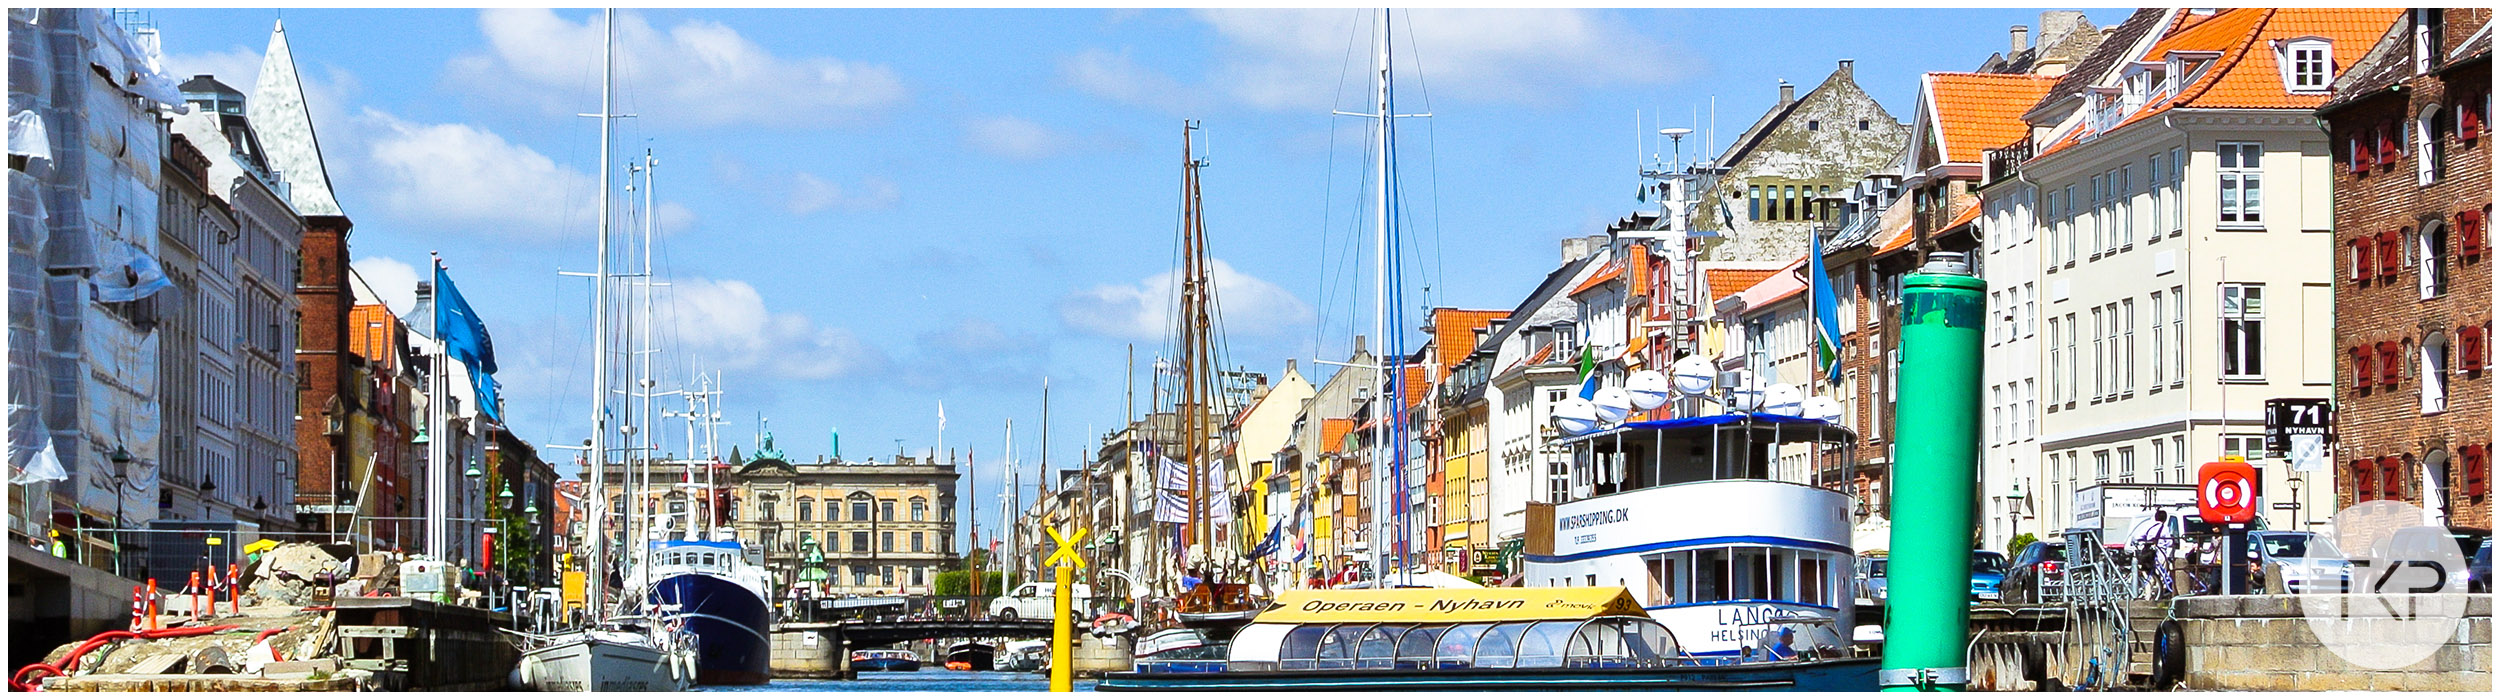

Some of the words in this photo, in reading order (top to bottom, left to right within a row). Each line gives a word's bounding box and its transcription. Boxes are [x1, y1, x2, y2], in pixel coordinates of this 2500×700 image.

[2266, 406, 2276, 425] 71
[2290, 405, 2319, 425] 71
[1302, 600, 1406, 613] Operaen
[1429, 599, 1525, 613] Nyhavn
[1615, 597, 1632, 611] 93
